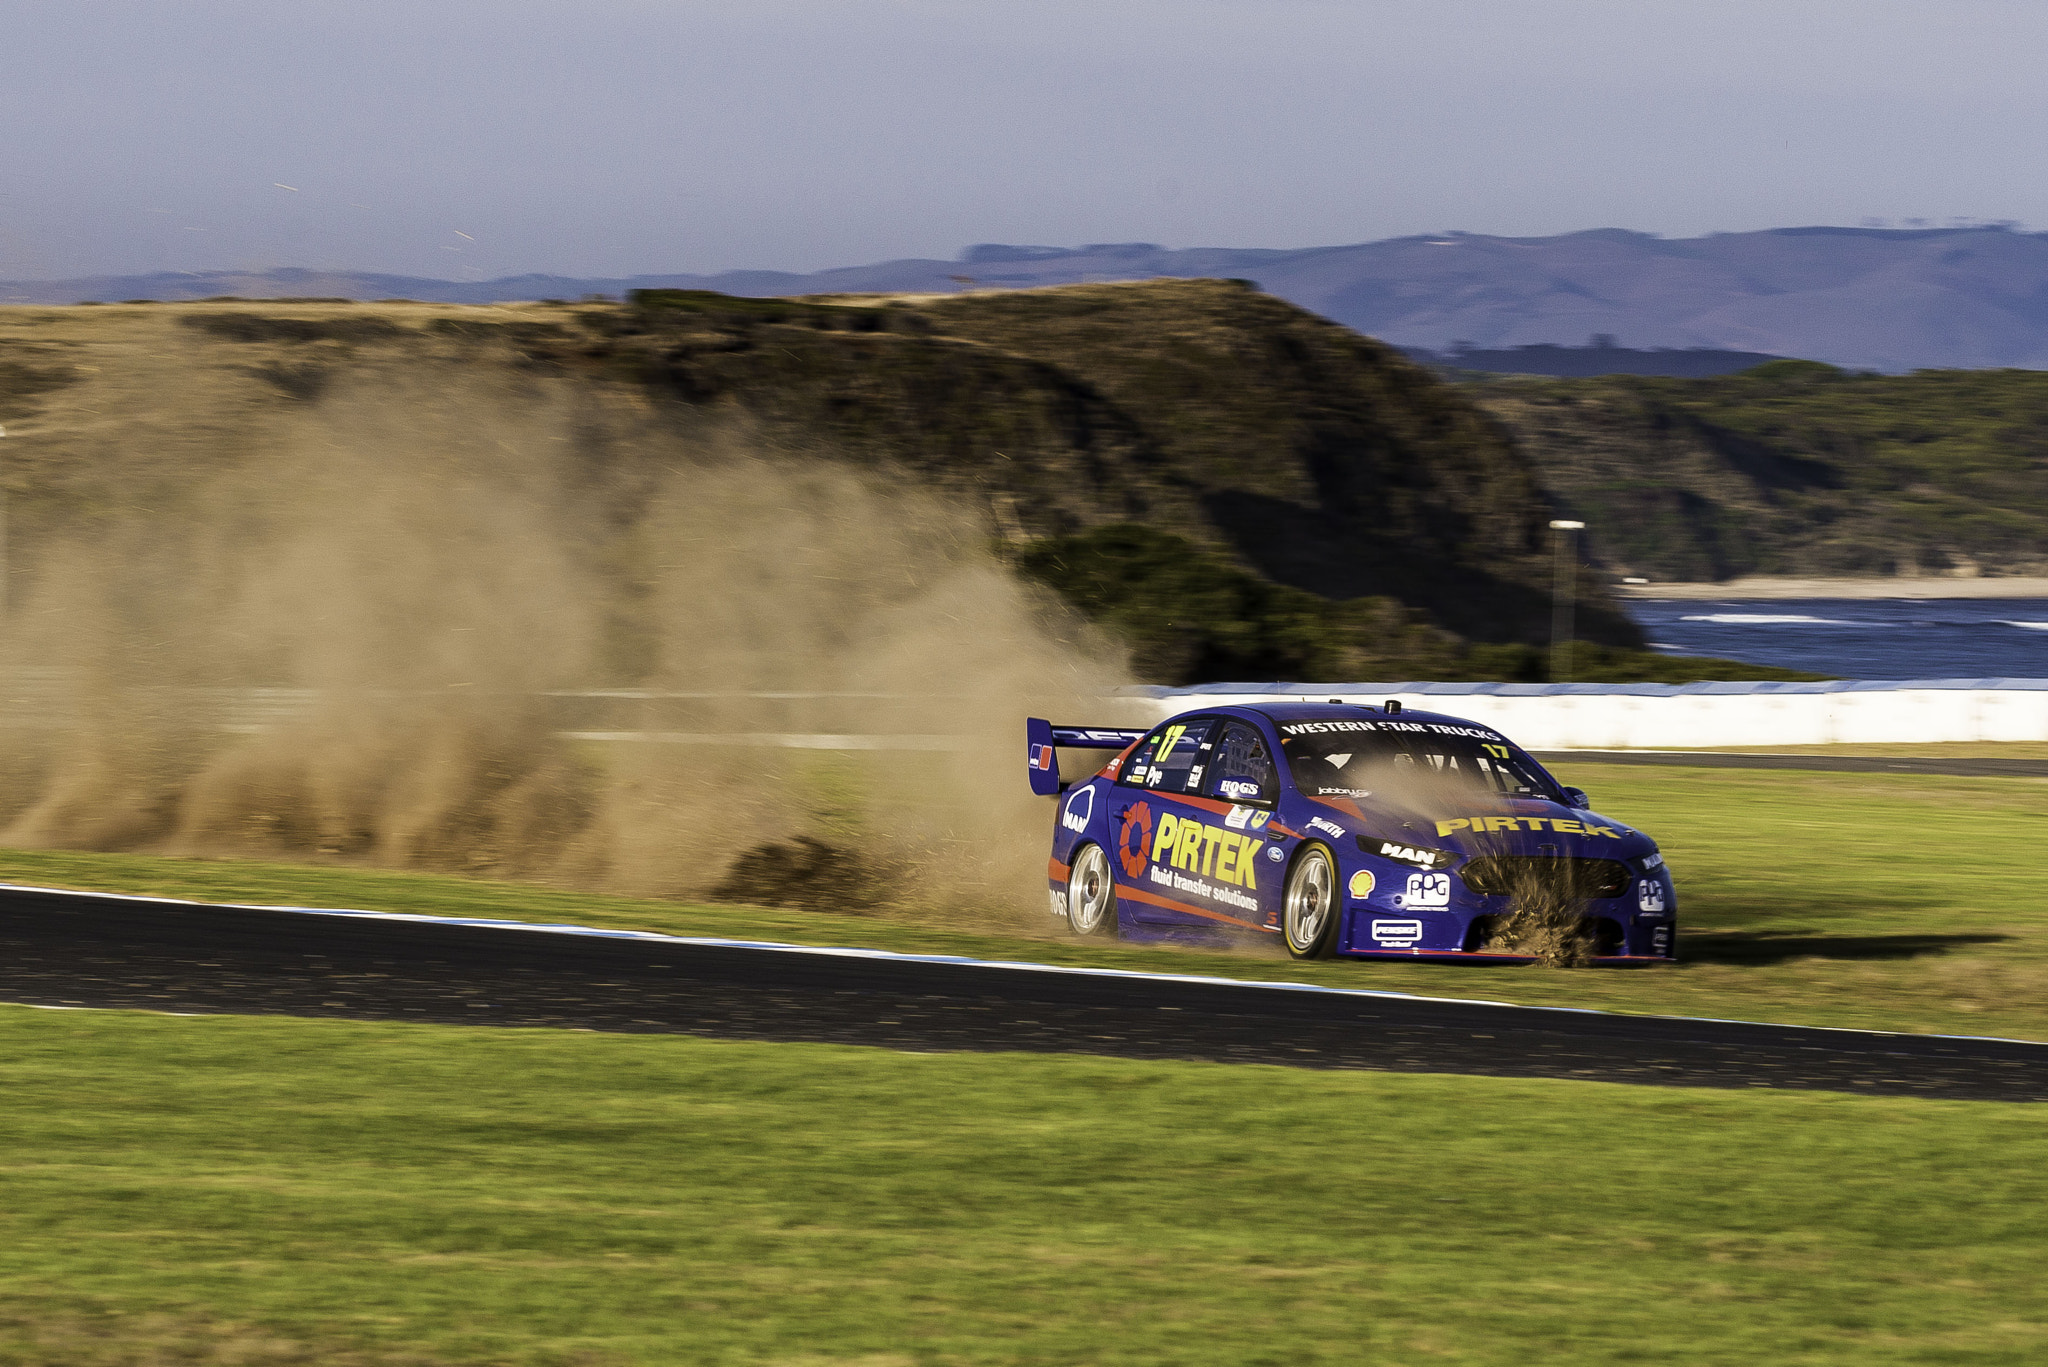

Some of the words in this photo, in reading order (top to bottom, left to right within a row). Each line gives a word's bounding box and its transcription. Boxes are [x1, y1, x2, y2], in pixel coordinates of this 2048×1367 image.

[1282, 721, 1377, 736] WESTERN
[1377, 721, 1428, 733] STAR
[1426, 723, 1502, 742] TRUCKS
[1155, 725, 1187, 762] 17
[1481, 743, 1509, 759] 17
[1146, 766, 1162, 787] Pye
[1220, 780, 1259, 795] HOGS
[1062, 811, 1087, 834] MAN
[1434, 816, 1621, 839] PIRTEK
[1151, 812, 1264, 890] PIRTEK
[1380, 842, 1436, 864] MAN
[1150, 865, 1173, 887] fluid
[1173, 873, 1212, 898] transfer
[1213, 886, 1258, 912] solutions
[1409, 873, 1448, 902] PPG
